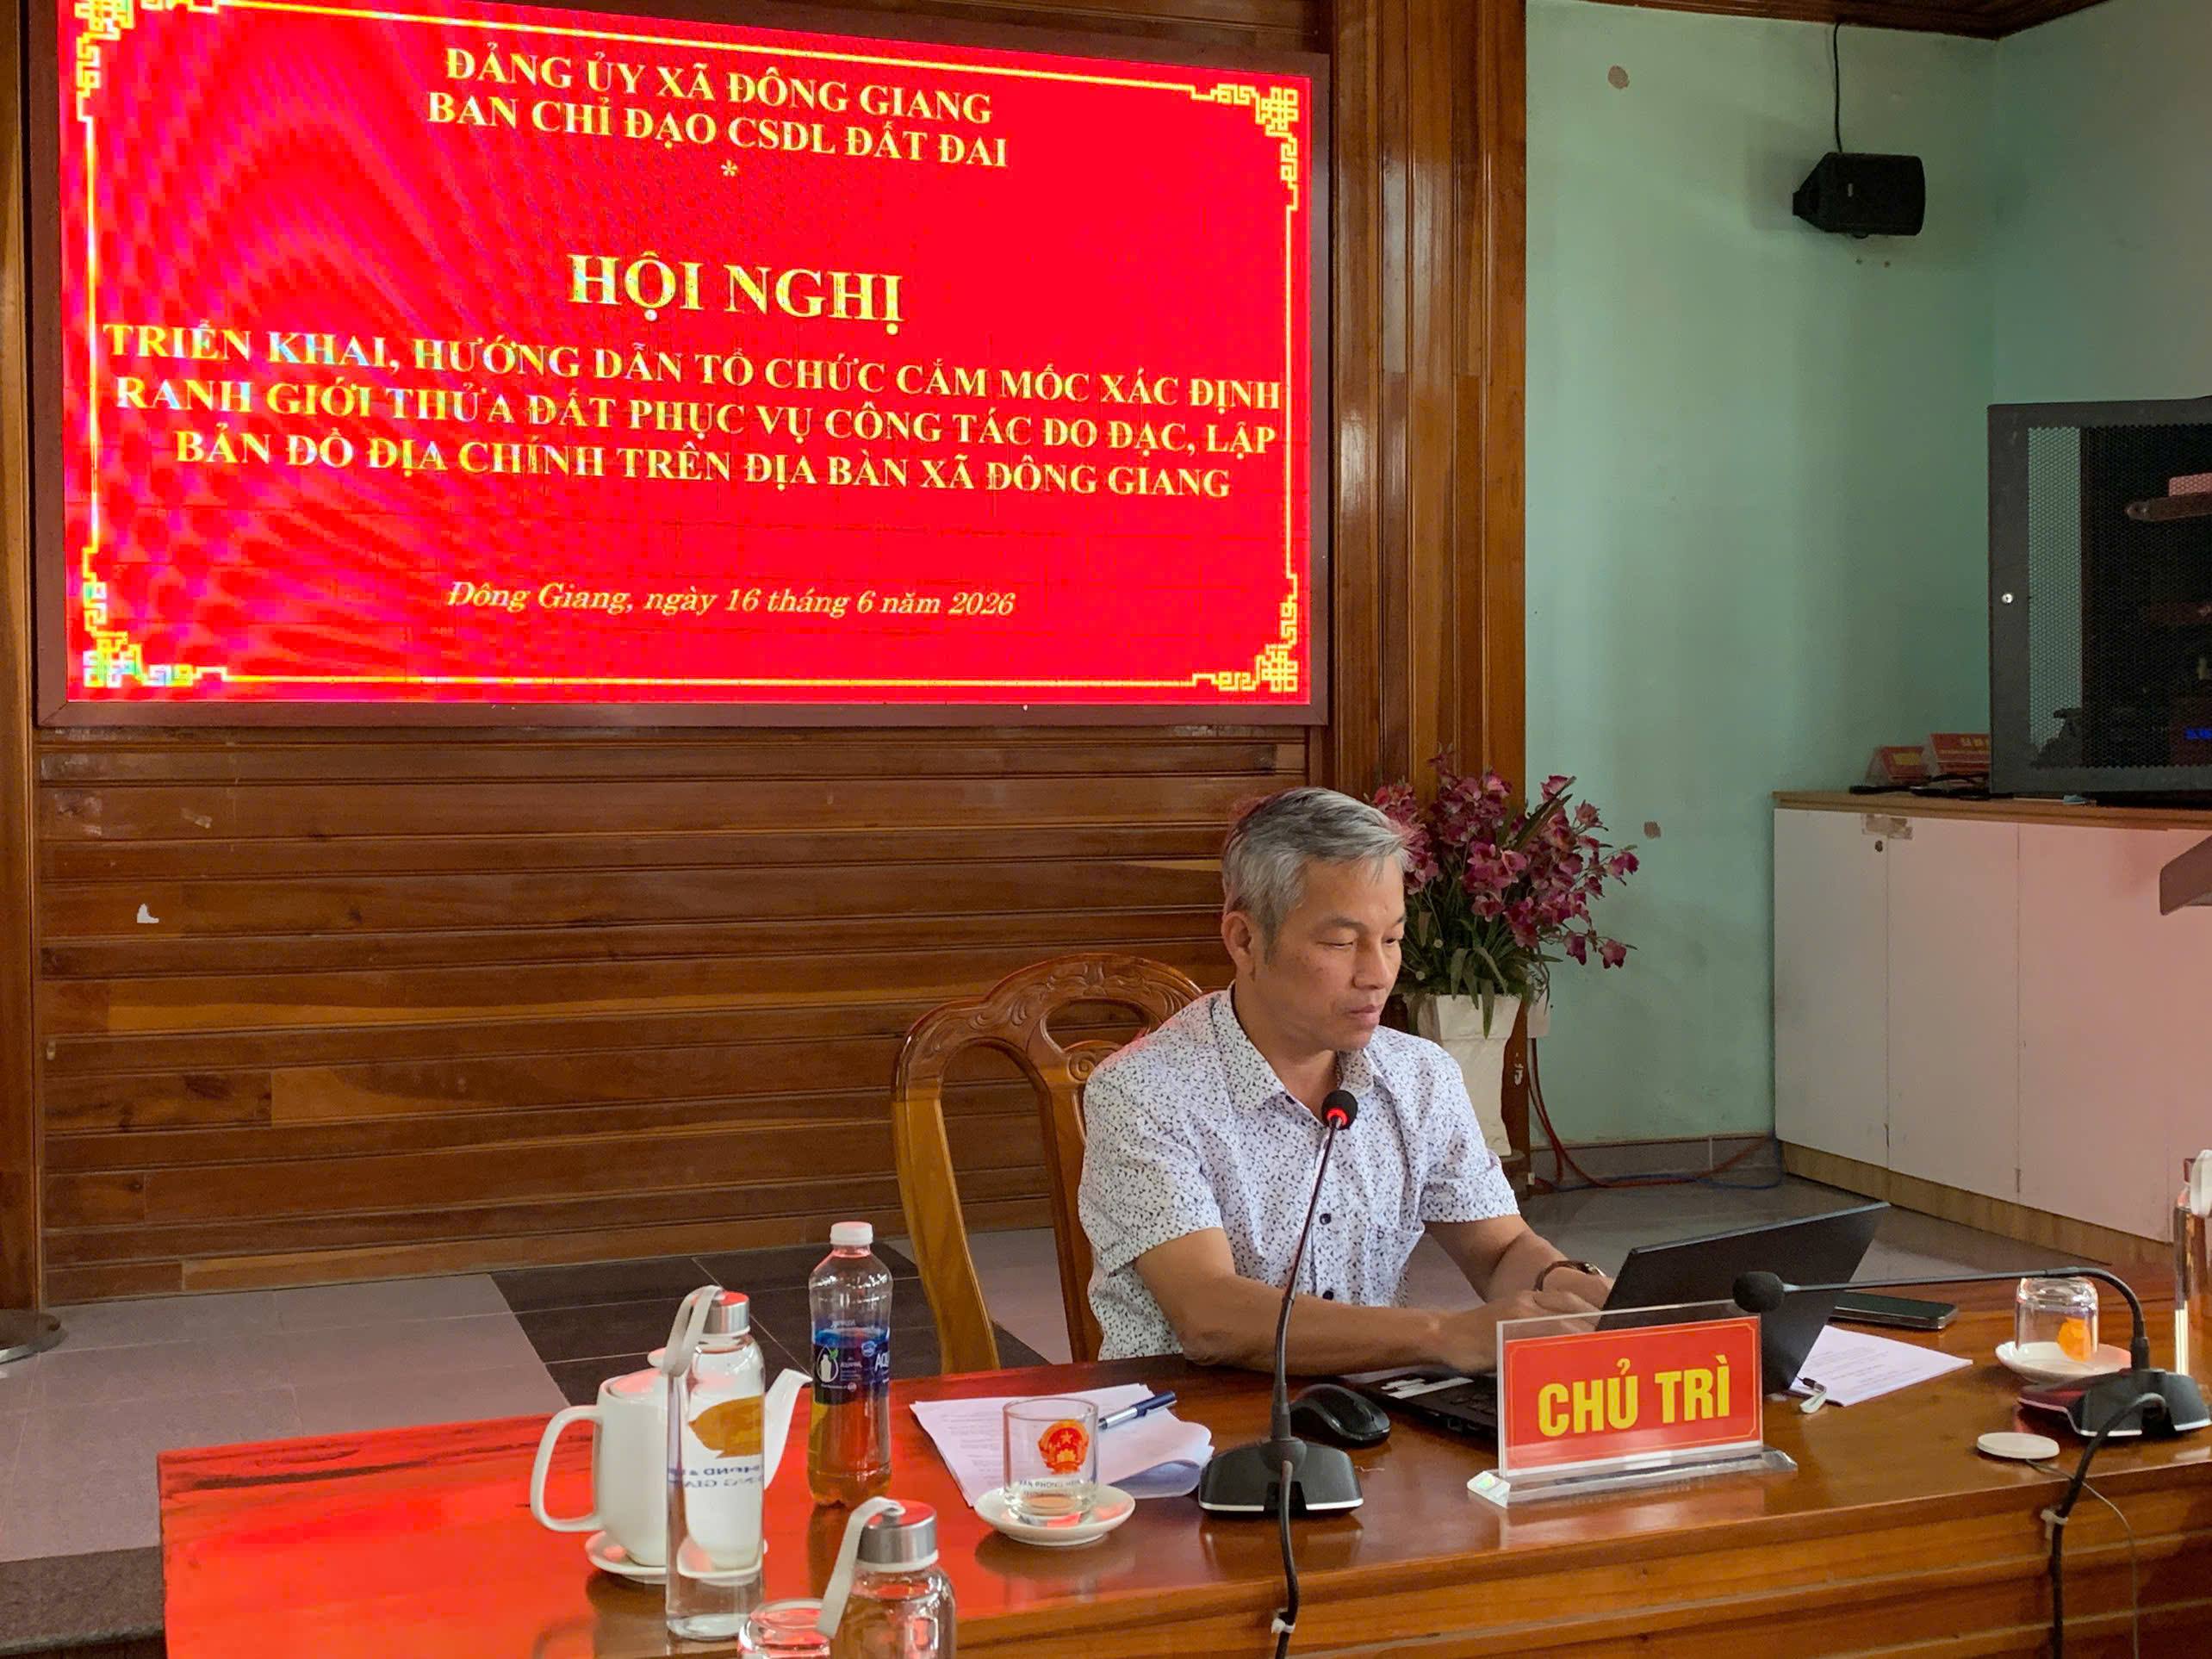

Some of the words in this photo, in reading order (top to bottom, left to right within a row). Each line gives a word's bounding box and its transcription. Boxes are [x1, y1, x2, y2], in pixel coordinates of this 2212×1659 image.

[446, 42, 573, 88] ĐẢNG
[586, 52, 645, 93] ỦY
[657, 63, 716, 101] XÃ
[726, 67, 848, 113] ĐÔNG
[859, 84, 992, 124] GIANG
[427, 91, 517, 129] BAN
[531, 95, 612, 136] CHỈ
[624, 109, 718, 150] ĐẠO
[727, 116, 836, 154] CSDL
[844, 121, 928, 161] ĐẤT
[938, 134, 1008, 167] ĐAI
[567, 251, 704, 321] HỘI
[723, 264, 904, 336] NGHỊ
[267, 331, 401, 372] KHAI,
[413, 334, 581, 378] HƯỚNG
[593, 341, 682, 383] DẪN
[695, 346, 754, 387] TỔ
[765, 351, 885, 393] CHỨC
[896, 356, 987, 398] CẮM
[1000, 363, 1090, 401] MỐC
[1100, 367, 1179, 406] XÁC
[1190, 377, 1283, 414] ĐỊNH
[115, 376, 253, 413] RANH
[266, 376, 372, 417] GIỚI
[385, 382, 515, 424] THỬA
[527, 386, 615, 428] ĐẤT
[629, 399, 745, 440] PHỤC
[757, 405, 813, 444] VỤ
[824, 401, 942, 443] CÔNG
[952, 407, 1032, 445] TÁC
[1042, 416, 1098, 450] ĐO
[1109, 419, 1196, 457] ĐẠC,
[1206, 419, 1277, 460] LẬP
[175, 422, 271, 464] BẢN
[286, 426, 354, 469] ĐỒ
[368, 438, 449, 477] ĐỊA
[458, 434, 606, 477] CHÍNH
[616, 440, 731, 482] TRÊN
[744, 451, 817, 492] ĐỊA
[827, 449, 908, 488] BÀN
[920, 454, 975, 490] XÃ
[985, 454, 1098, 495] ĐÔNG
[1107, 465, 1231, 499] GIANG
[447, 581, 531, 612] Đông
[537, 582, 635, 615] Giang,
[643, 585, 718, 616] ngày
[725, 588, 760, 612] 16
[767, 587, 849, 618] tháng
[856, 590, 874, 613] 6
[881, 593, 942, 615] năm
[948, 592, 1016, 617] 2026
[1538, 1357, 1639, 1438] CHỦ
[1654, 1353, 1731, 1424] TRÌ
